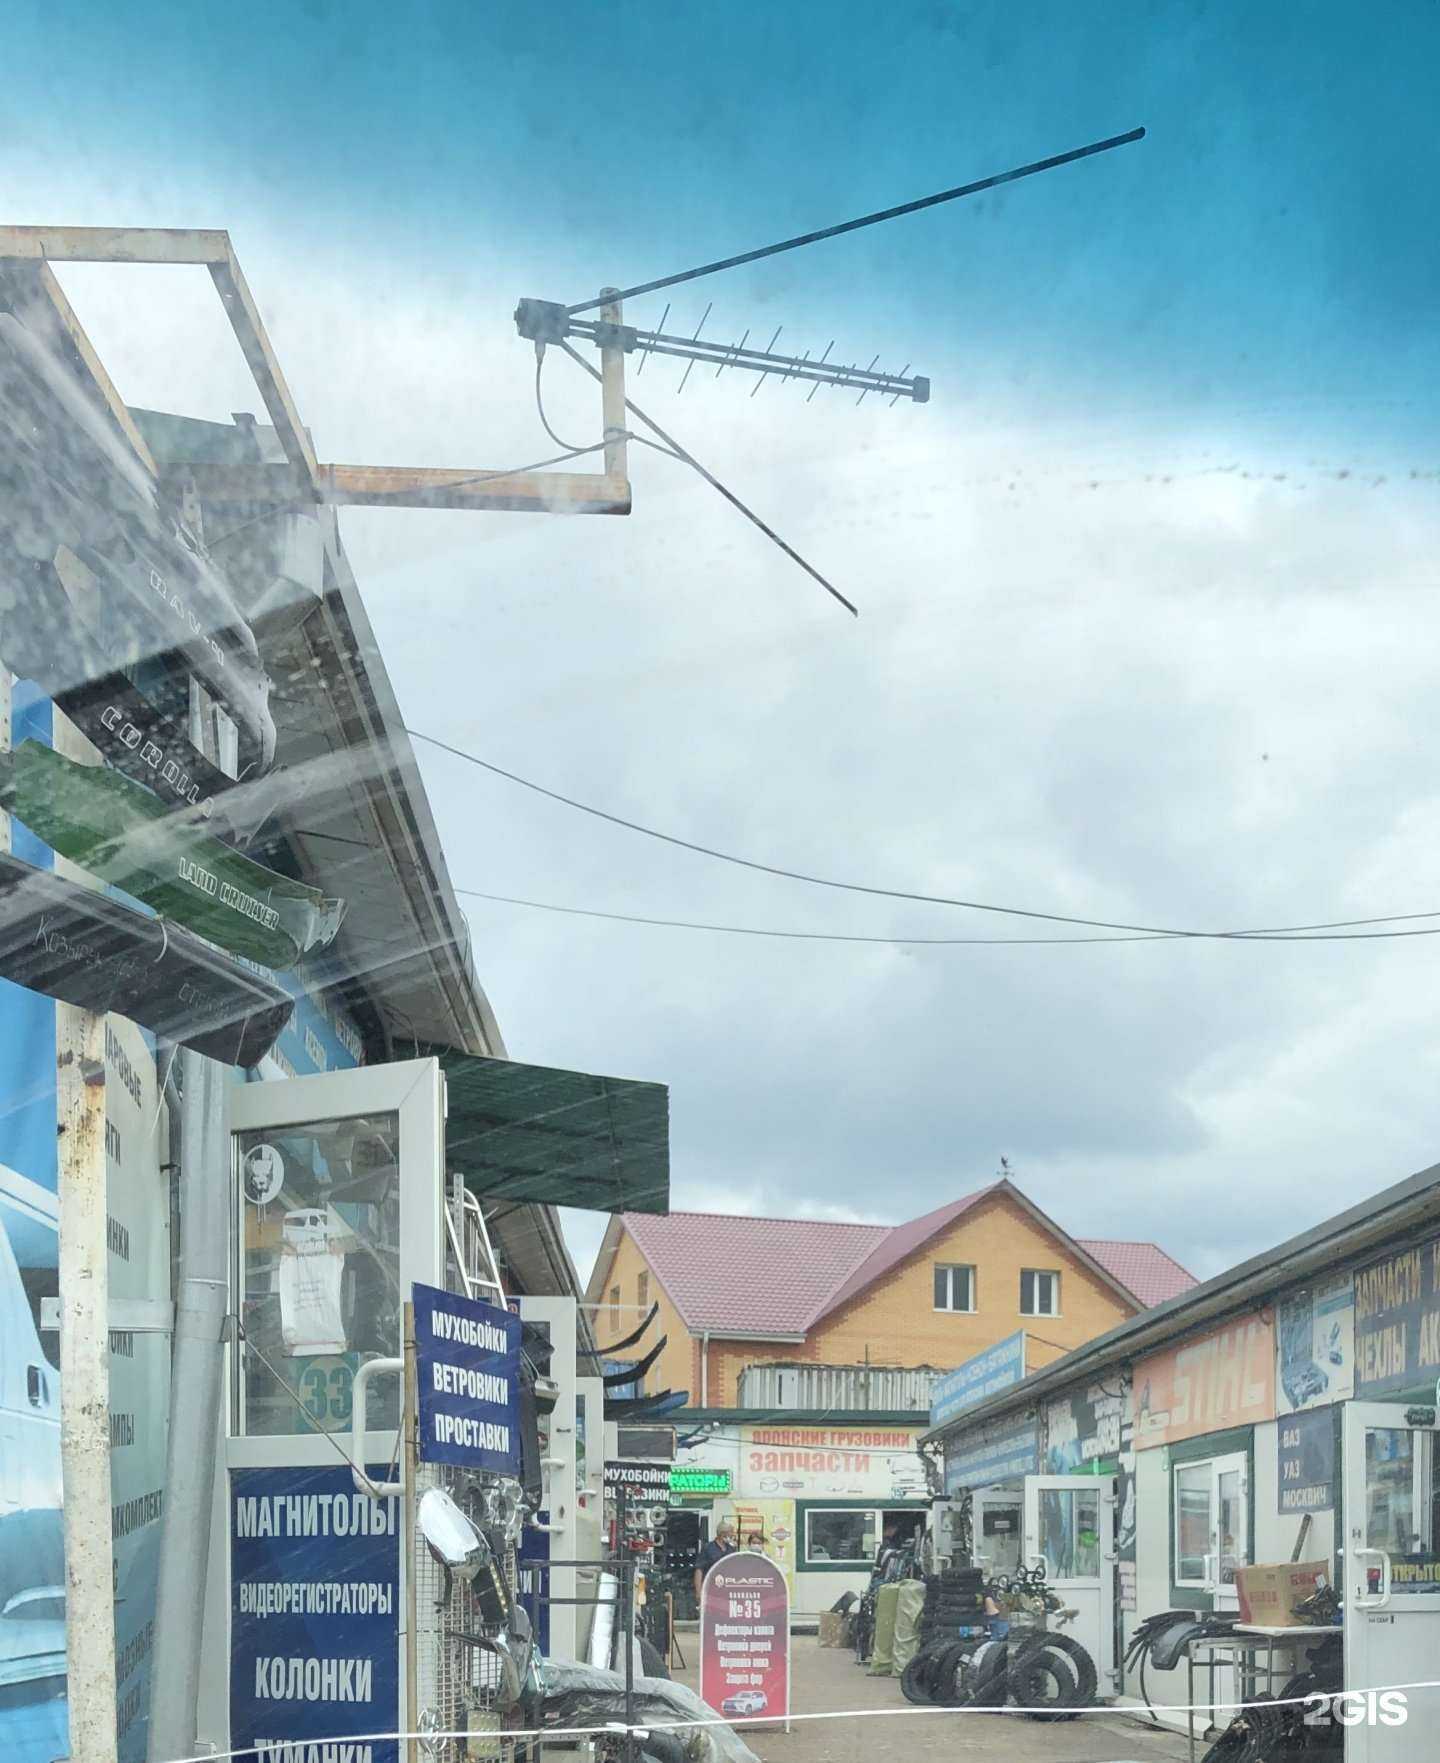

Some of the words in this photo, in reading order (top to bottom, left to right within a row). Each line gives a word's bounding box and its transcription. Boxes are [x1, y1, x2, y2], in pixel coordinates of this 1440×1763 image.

[101, 706, 215, 818] COROLLA
[178, 856, 218, 896] LAND
[219, 883, 280, 930] CRUISER
[431, 1310, 507, 1354] МУХОБОЙКИ
[304, 1367, 353, 1419] 33
[433, 1362, 508, 1406] ВЕТРОВИКИ
[435, 1413, 509, 1453] ПРОСТАВКИ
[831, 1431, 910, 1447] ГРУЗОВИКИ
[1283, 1428, 1300, 1448] ВАЗ
[604, 1468, 670, 1483] МУХОБОЙКИ
[1283, 1460, 1300, 1480] УАЗ
[237, 1494, 395, 1537] МАГНИТОЛЫ
[1283, 1486, 1327, 1508] МОСКВИЧ
[239, 1583, 392, 1618] ВИДЕОРЕГИСТРАТОРЫ
[725, 1577, 774, 1585] PLASTIC
[255, 1656, 372, 1702] КОЛОНКИ
